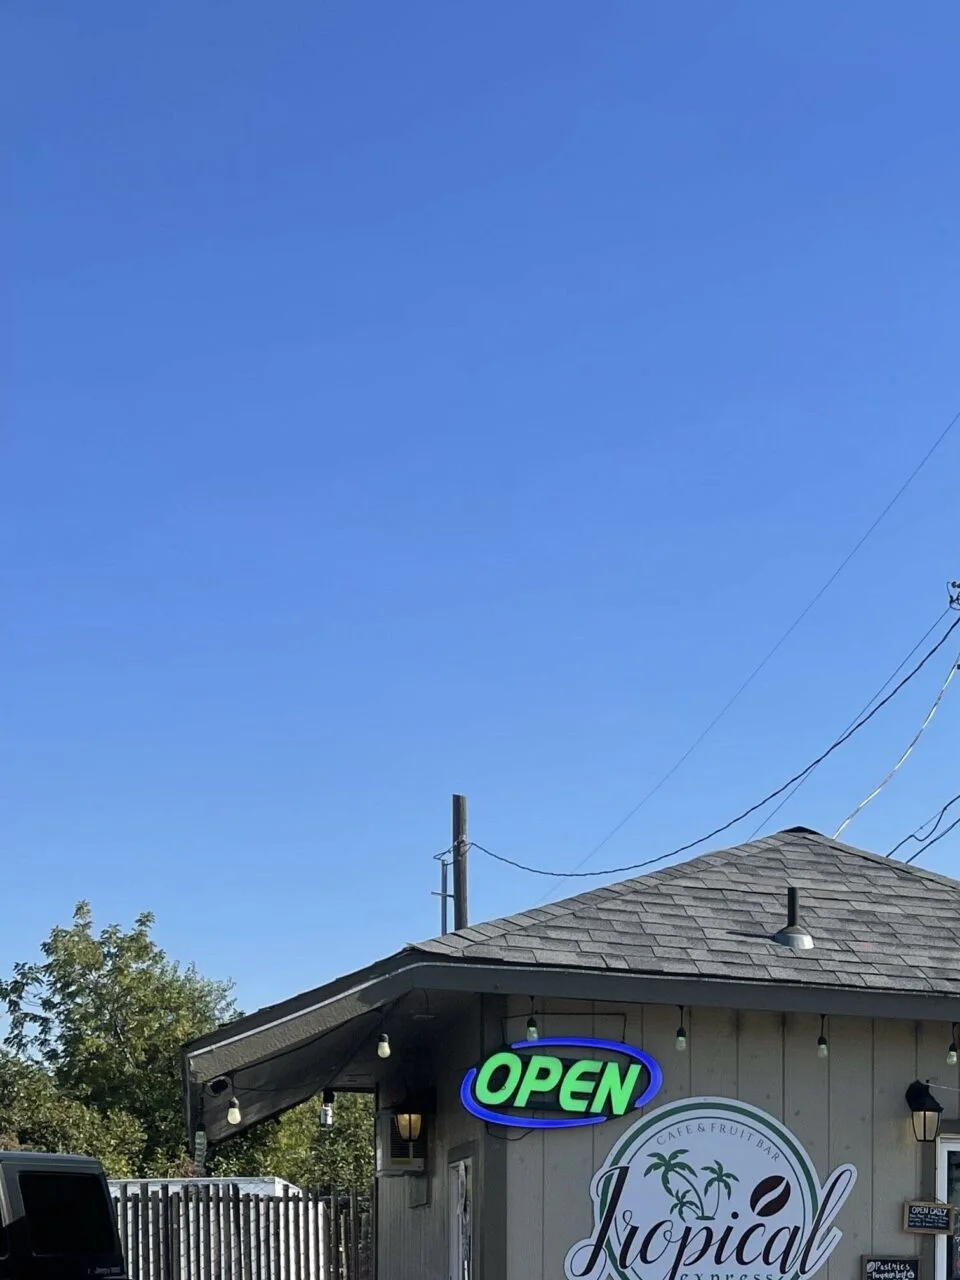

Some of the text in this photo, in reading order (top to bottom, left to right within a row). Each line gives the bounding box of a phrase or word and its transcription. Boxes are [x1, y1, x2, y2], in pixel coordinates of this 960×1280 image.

[475, 1052, 642, 1116] OPEN
[656, 1122, 780, 1162] CAFE & FRUIT BAR
[911, 1206, 948, 1216] OPEN DAILY
[875, 1261, 910, 1271] Pastries
